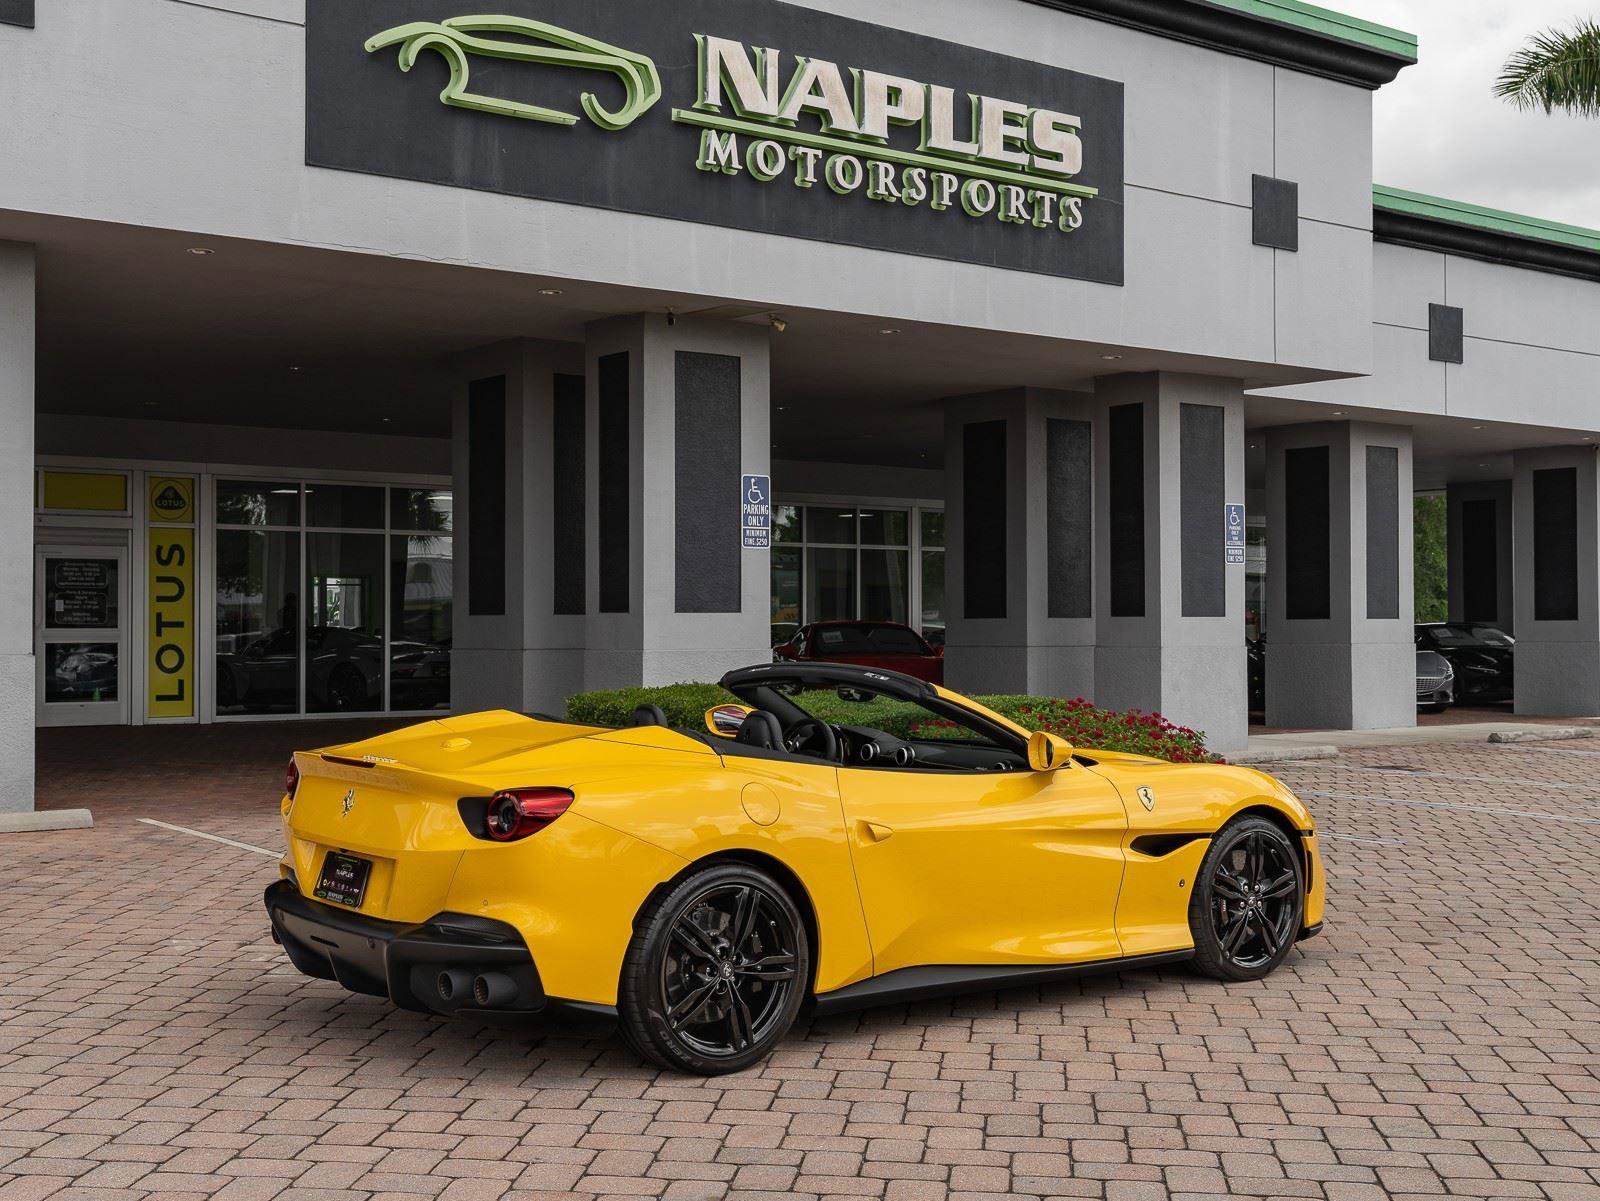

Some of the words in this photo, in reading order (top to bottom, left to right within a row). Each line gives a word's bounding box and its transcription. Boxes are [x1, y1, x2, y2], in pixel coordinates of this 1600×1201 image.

[692, 32, 1083, 178] NAPLES
[696, 129, 1083, 232] MOTORSPORTS
[157, 499, 185, 508] LOTUS
[743, 503, 769, 515] PARKING
[747, 515, 764, 526] ONLY
[745, 529, 767, 537] MINIMUM
[744, 537, 755, 545] FINE
[756, 537, 768, 546] $250
[155, 543, 185, 702] LOTUS
